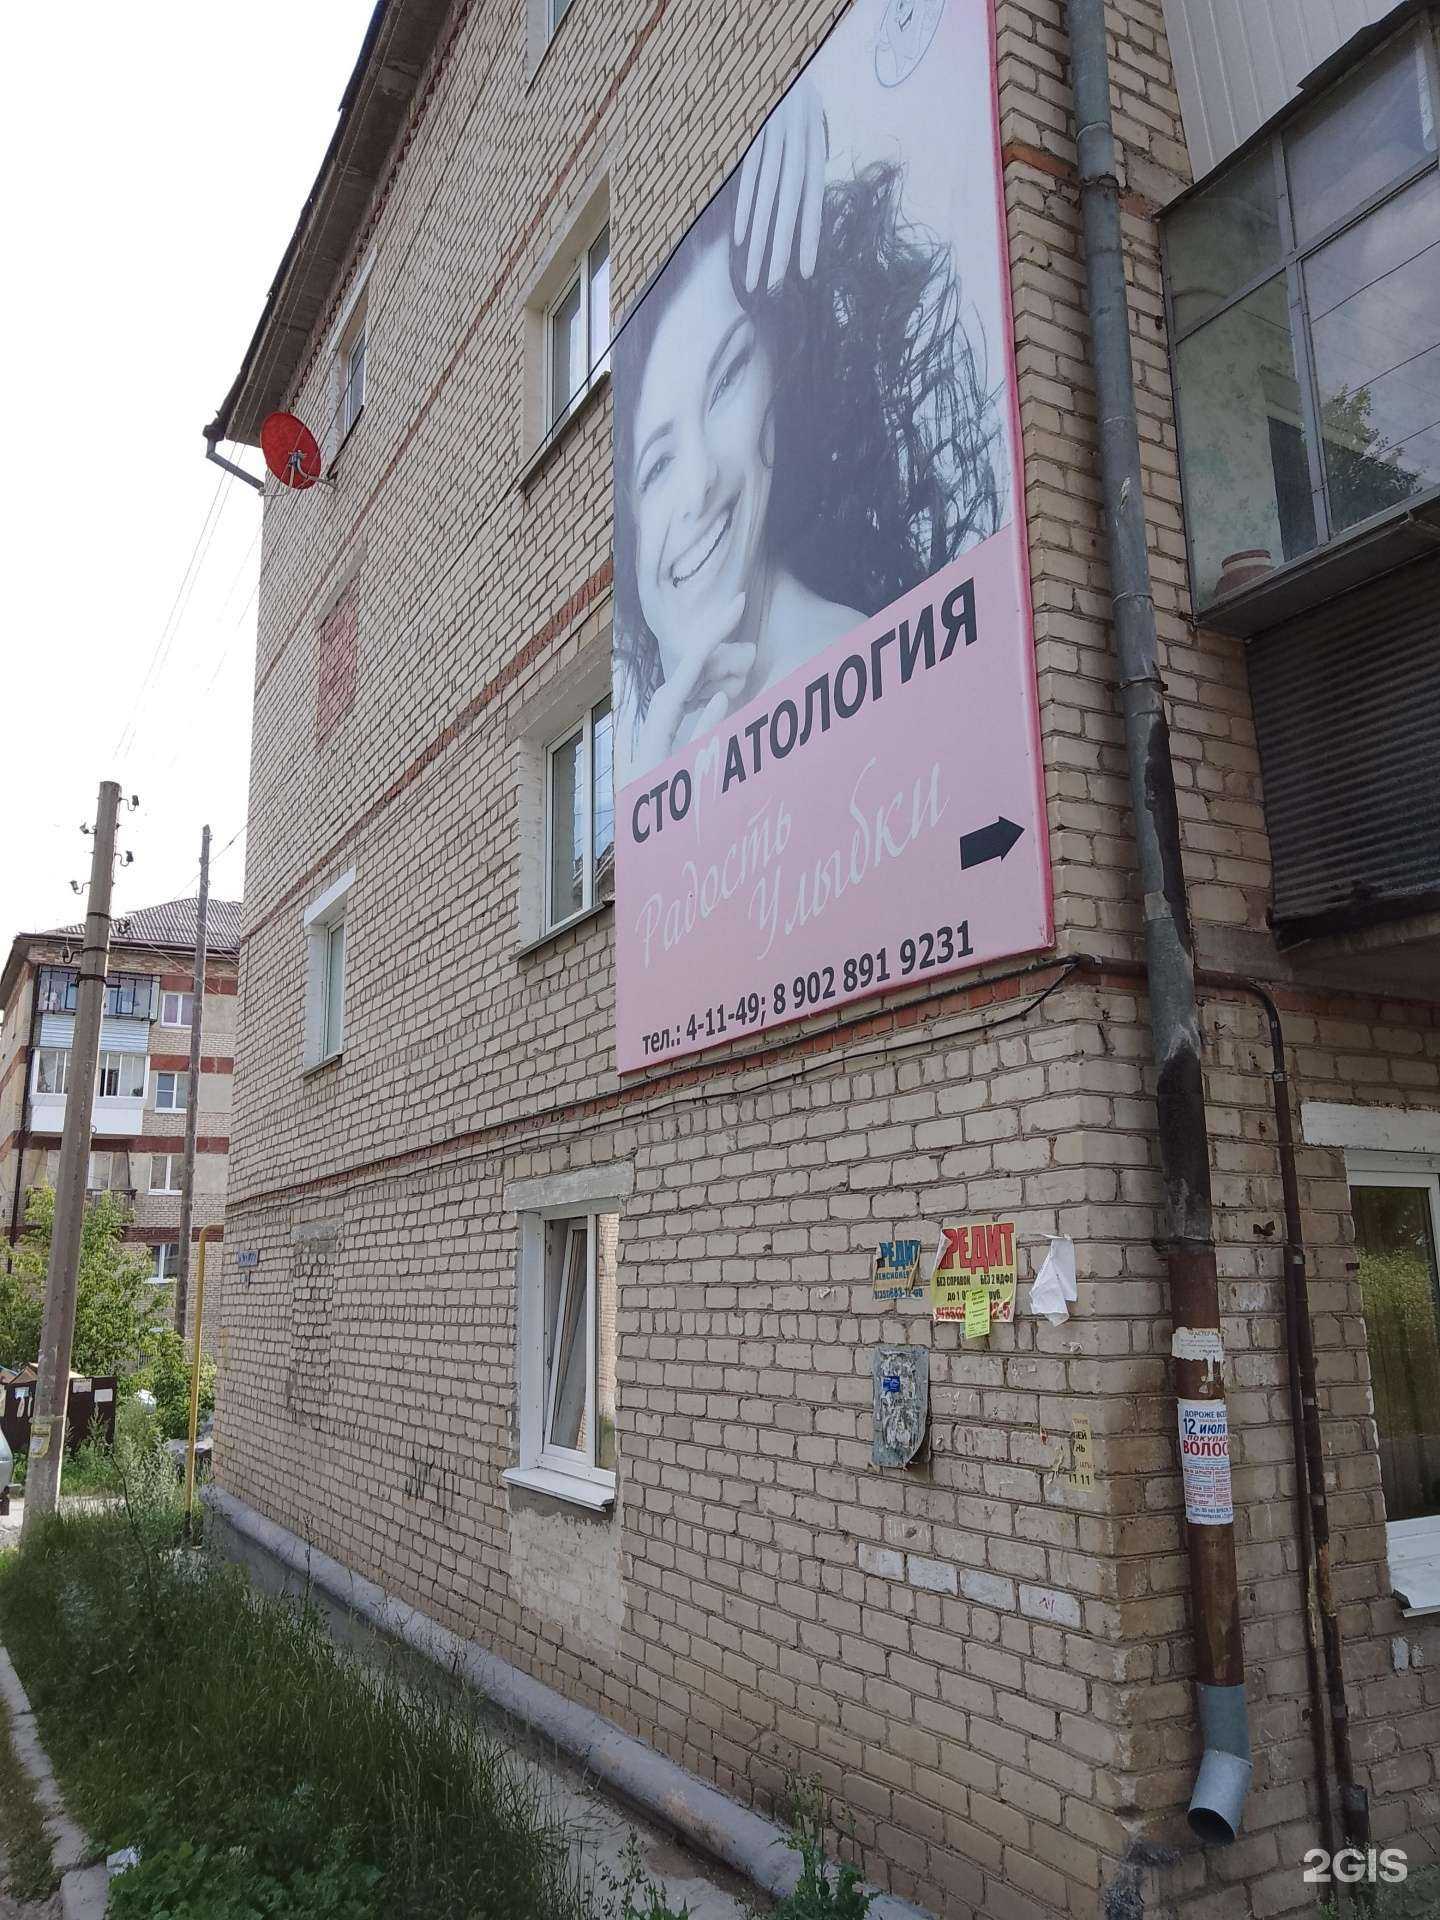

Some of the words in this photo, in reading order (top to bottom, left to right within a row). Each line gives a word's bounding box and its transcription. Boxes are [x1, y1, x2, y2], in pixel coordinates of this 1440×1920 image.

[635, 794, 792, 969] Радость
[748, 756, 950, 960] Улыбки
[642, 1025, 681, 1055] тел.:
[686, 993, 766, 1041] 4-11-49;
[773, 983, 786, 1014] 8
[792, 966, 836, 1009] 902
[843, 947, 890, 993] 891
[899, 919, 974, 976] 9231
[940, 1222, 1015, 1274] РЕДИТ
[1183, 1417, 1197, 1434] 12
[1184, 1410, 1216, 1419] ДОРОЖЕ
